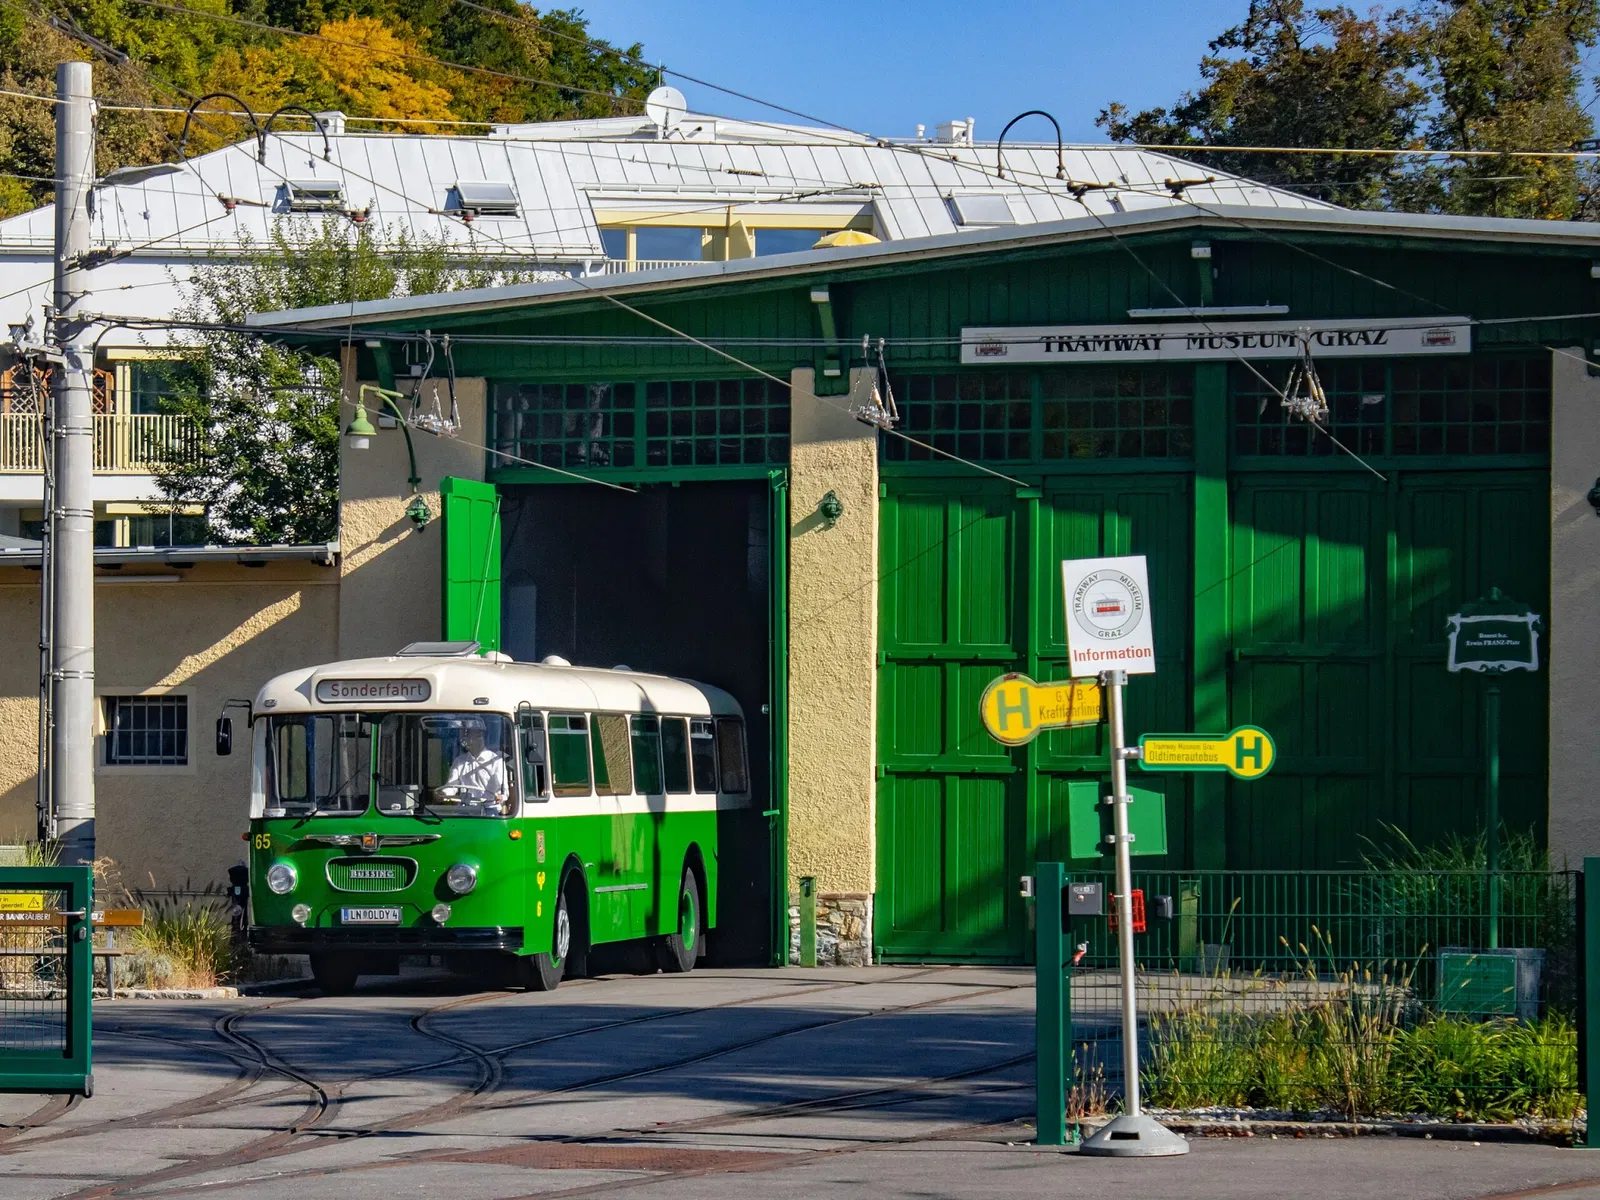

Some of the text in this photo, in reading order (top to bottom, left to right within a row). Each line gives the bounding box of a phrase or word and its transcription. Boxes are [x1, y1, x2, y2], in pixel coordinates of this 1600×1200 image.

[1040, 329, 1389, 353] TRAMWAY MUSEUM GRAZ
[1075, 573, 1142, 638] TRAMWAY MUSEUM GRAZ
[1073, 645, 1152, 662] Information
[330, 682, 423, 697] Sonderfahrt
[996, 687, 1032, 732] H
[1152, 742, 1177, 752] Tramway
[1178, 742, 1201, 750] Museum
[1235, 736, 1263, 769] H
[1149, 750, 1219, 762] Oldtimerautobus
[350, 909, 399, 920] LN OLDY 4
